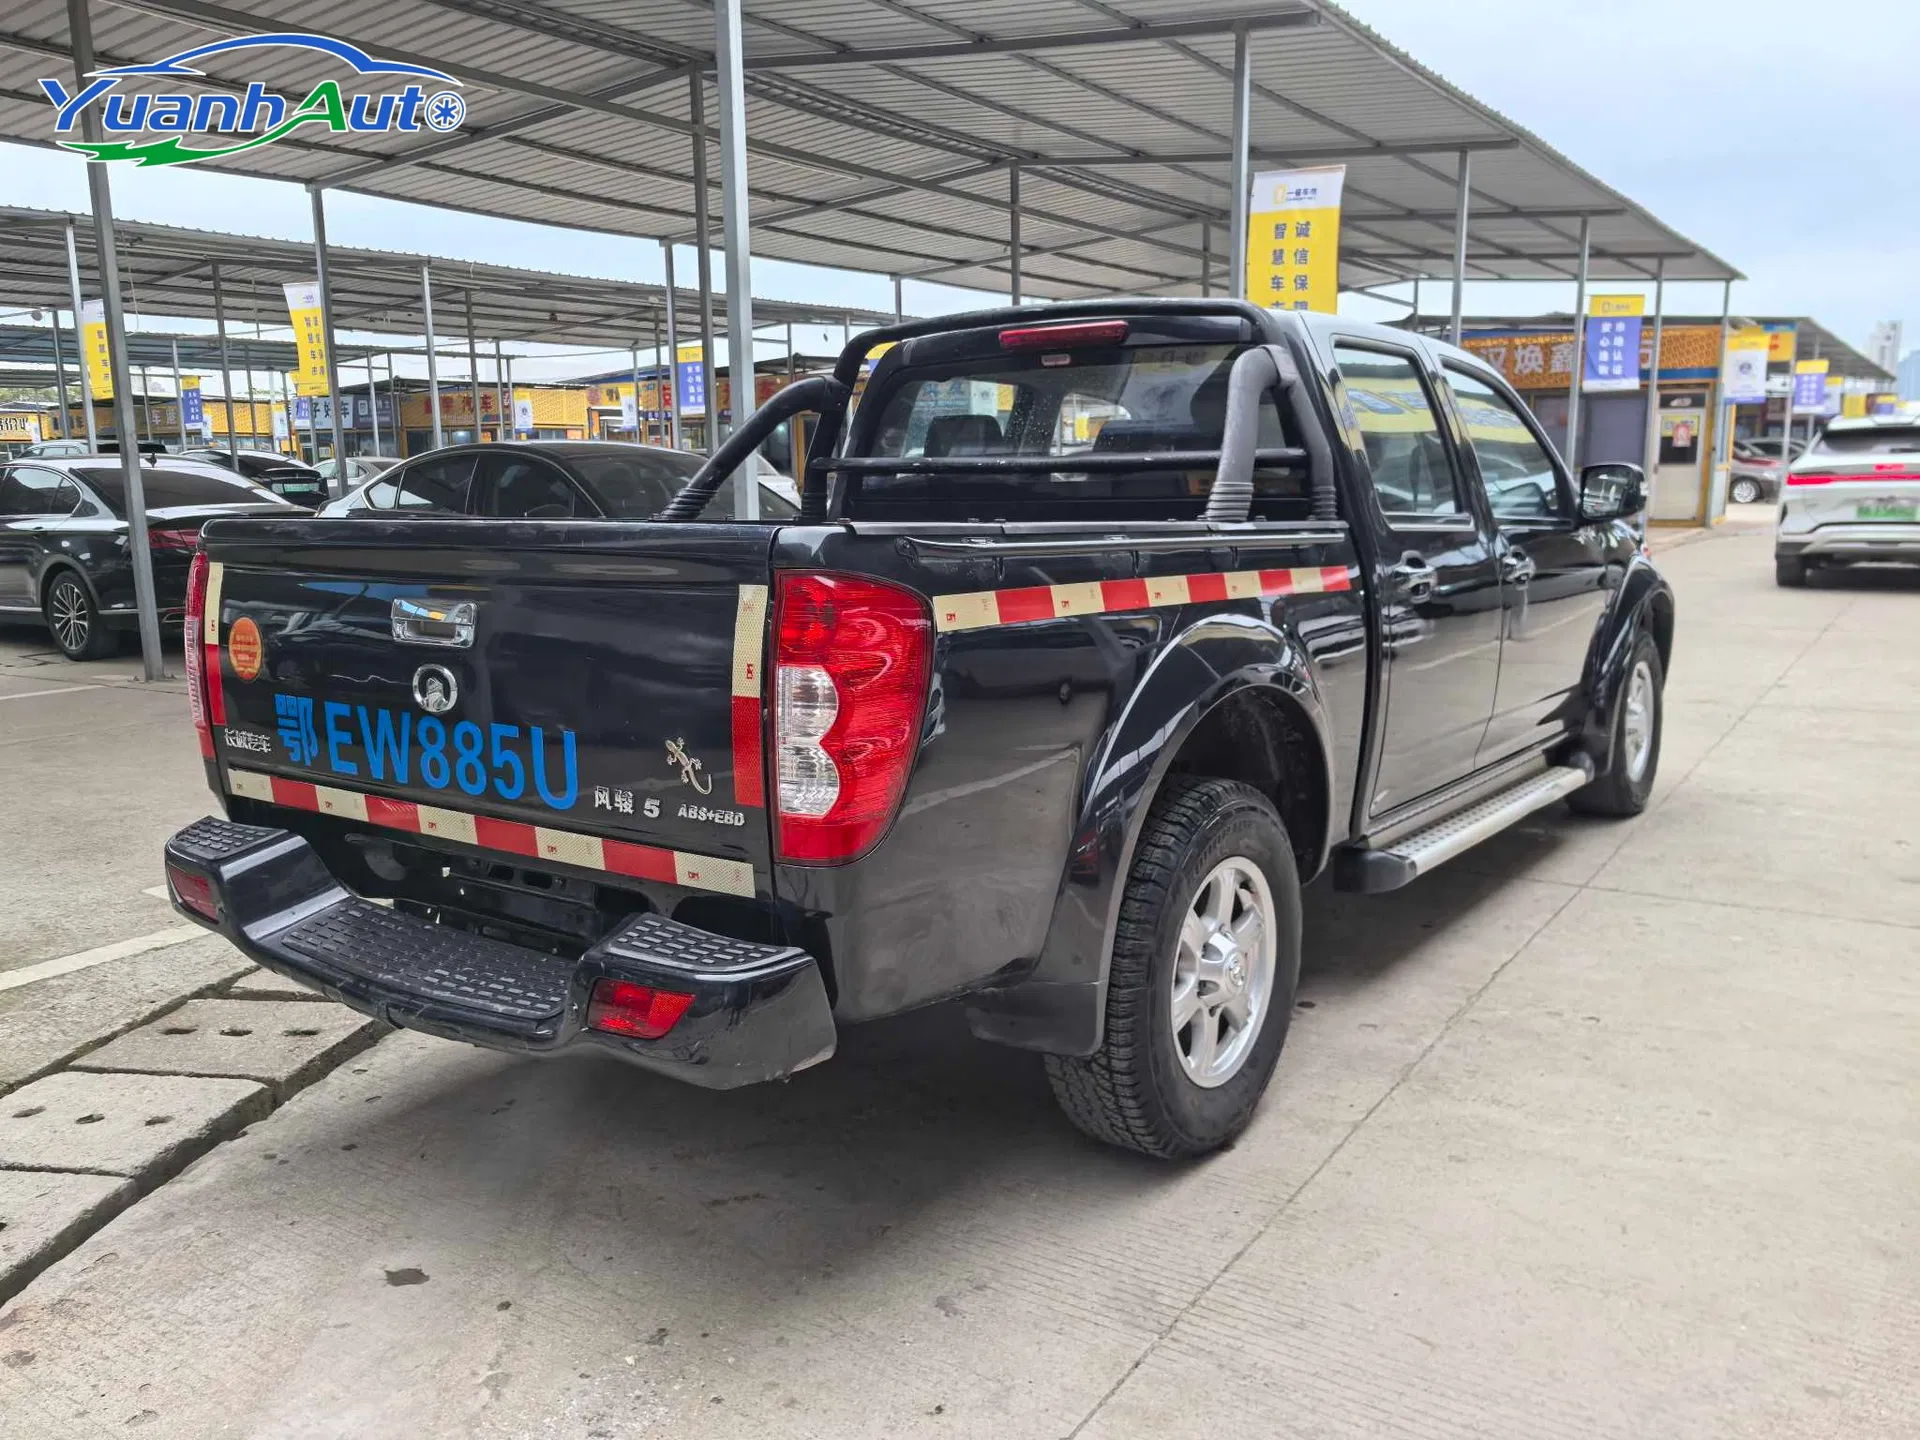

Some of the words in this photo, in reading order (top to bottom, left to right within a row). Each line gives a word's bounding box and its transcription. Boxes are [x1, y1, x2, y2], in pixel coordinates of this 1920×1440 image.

[274, 693, 579, 810] 鄂EW885U
[594, 785, 634, 815] 风骏
[643, 798, 661, 818] 5
[677, 803, 746, 827] ABS+EBD
